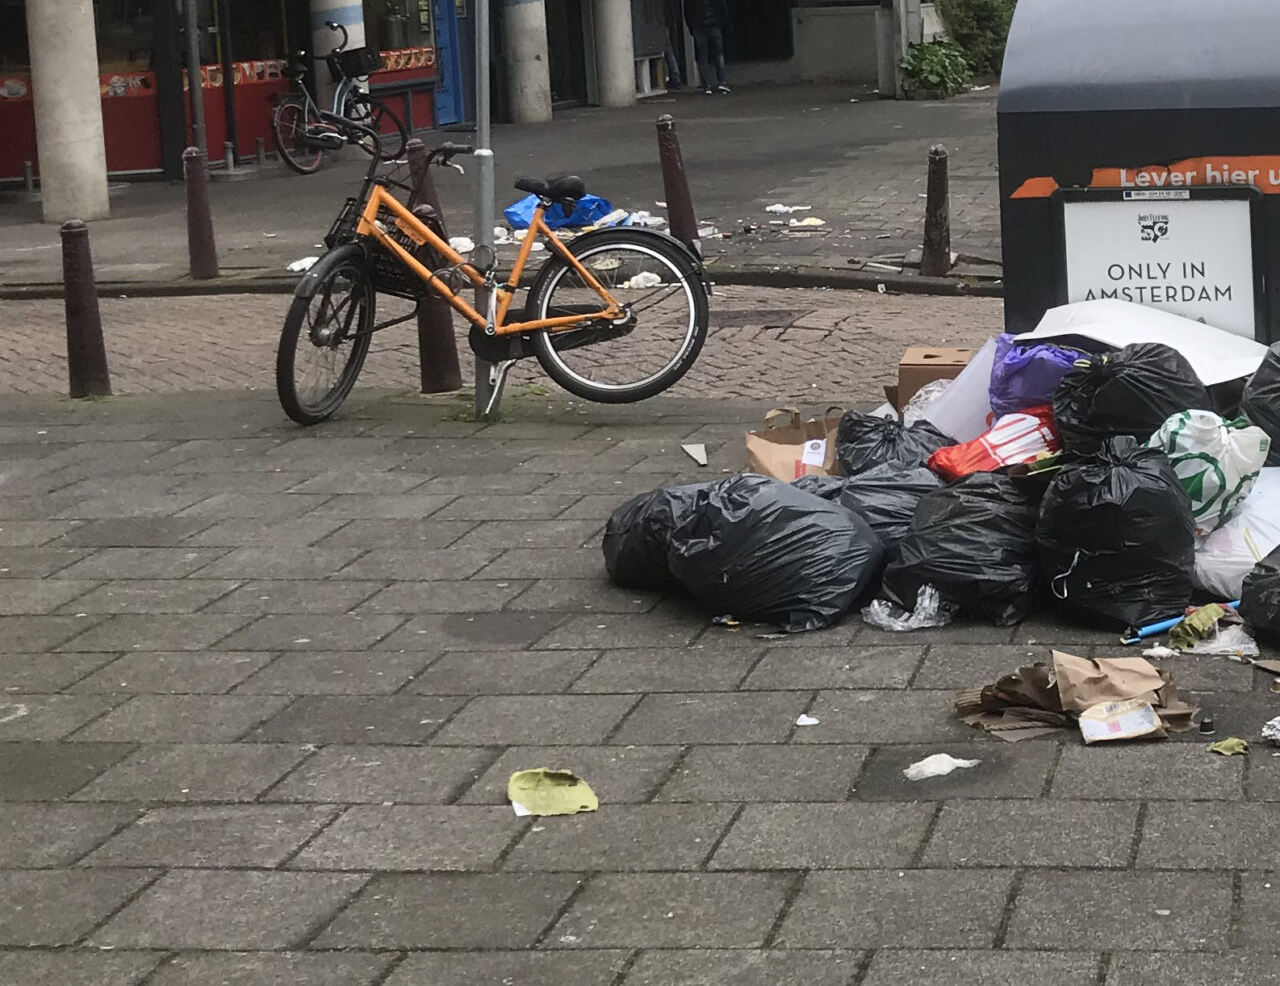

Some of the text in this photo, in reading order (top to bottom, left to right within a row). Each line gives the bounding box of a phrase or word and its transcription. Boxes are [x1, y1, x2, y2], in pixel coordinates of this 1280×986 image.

[1120, 168, 1197, 187] Lever
[1206, 163, 1260, 186] hier
[1107, 261, 1206, 281] ONLY IN
[1084, 284, 1233, 304] AMSTERDAM
